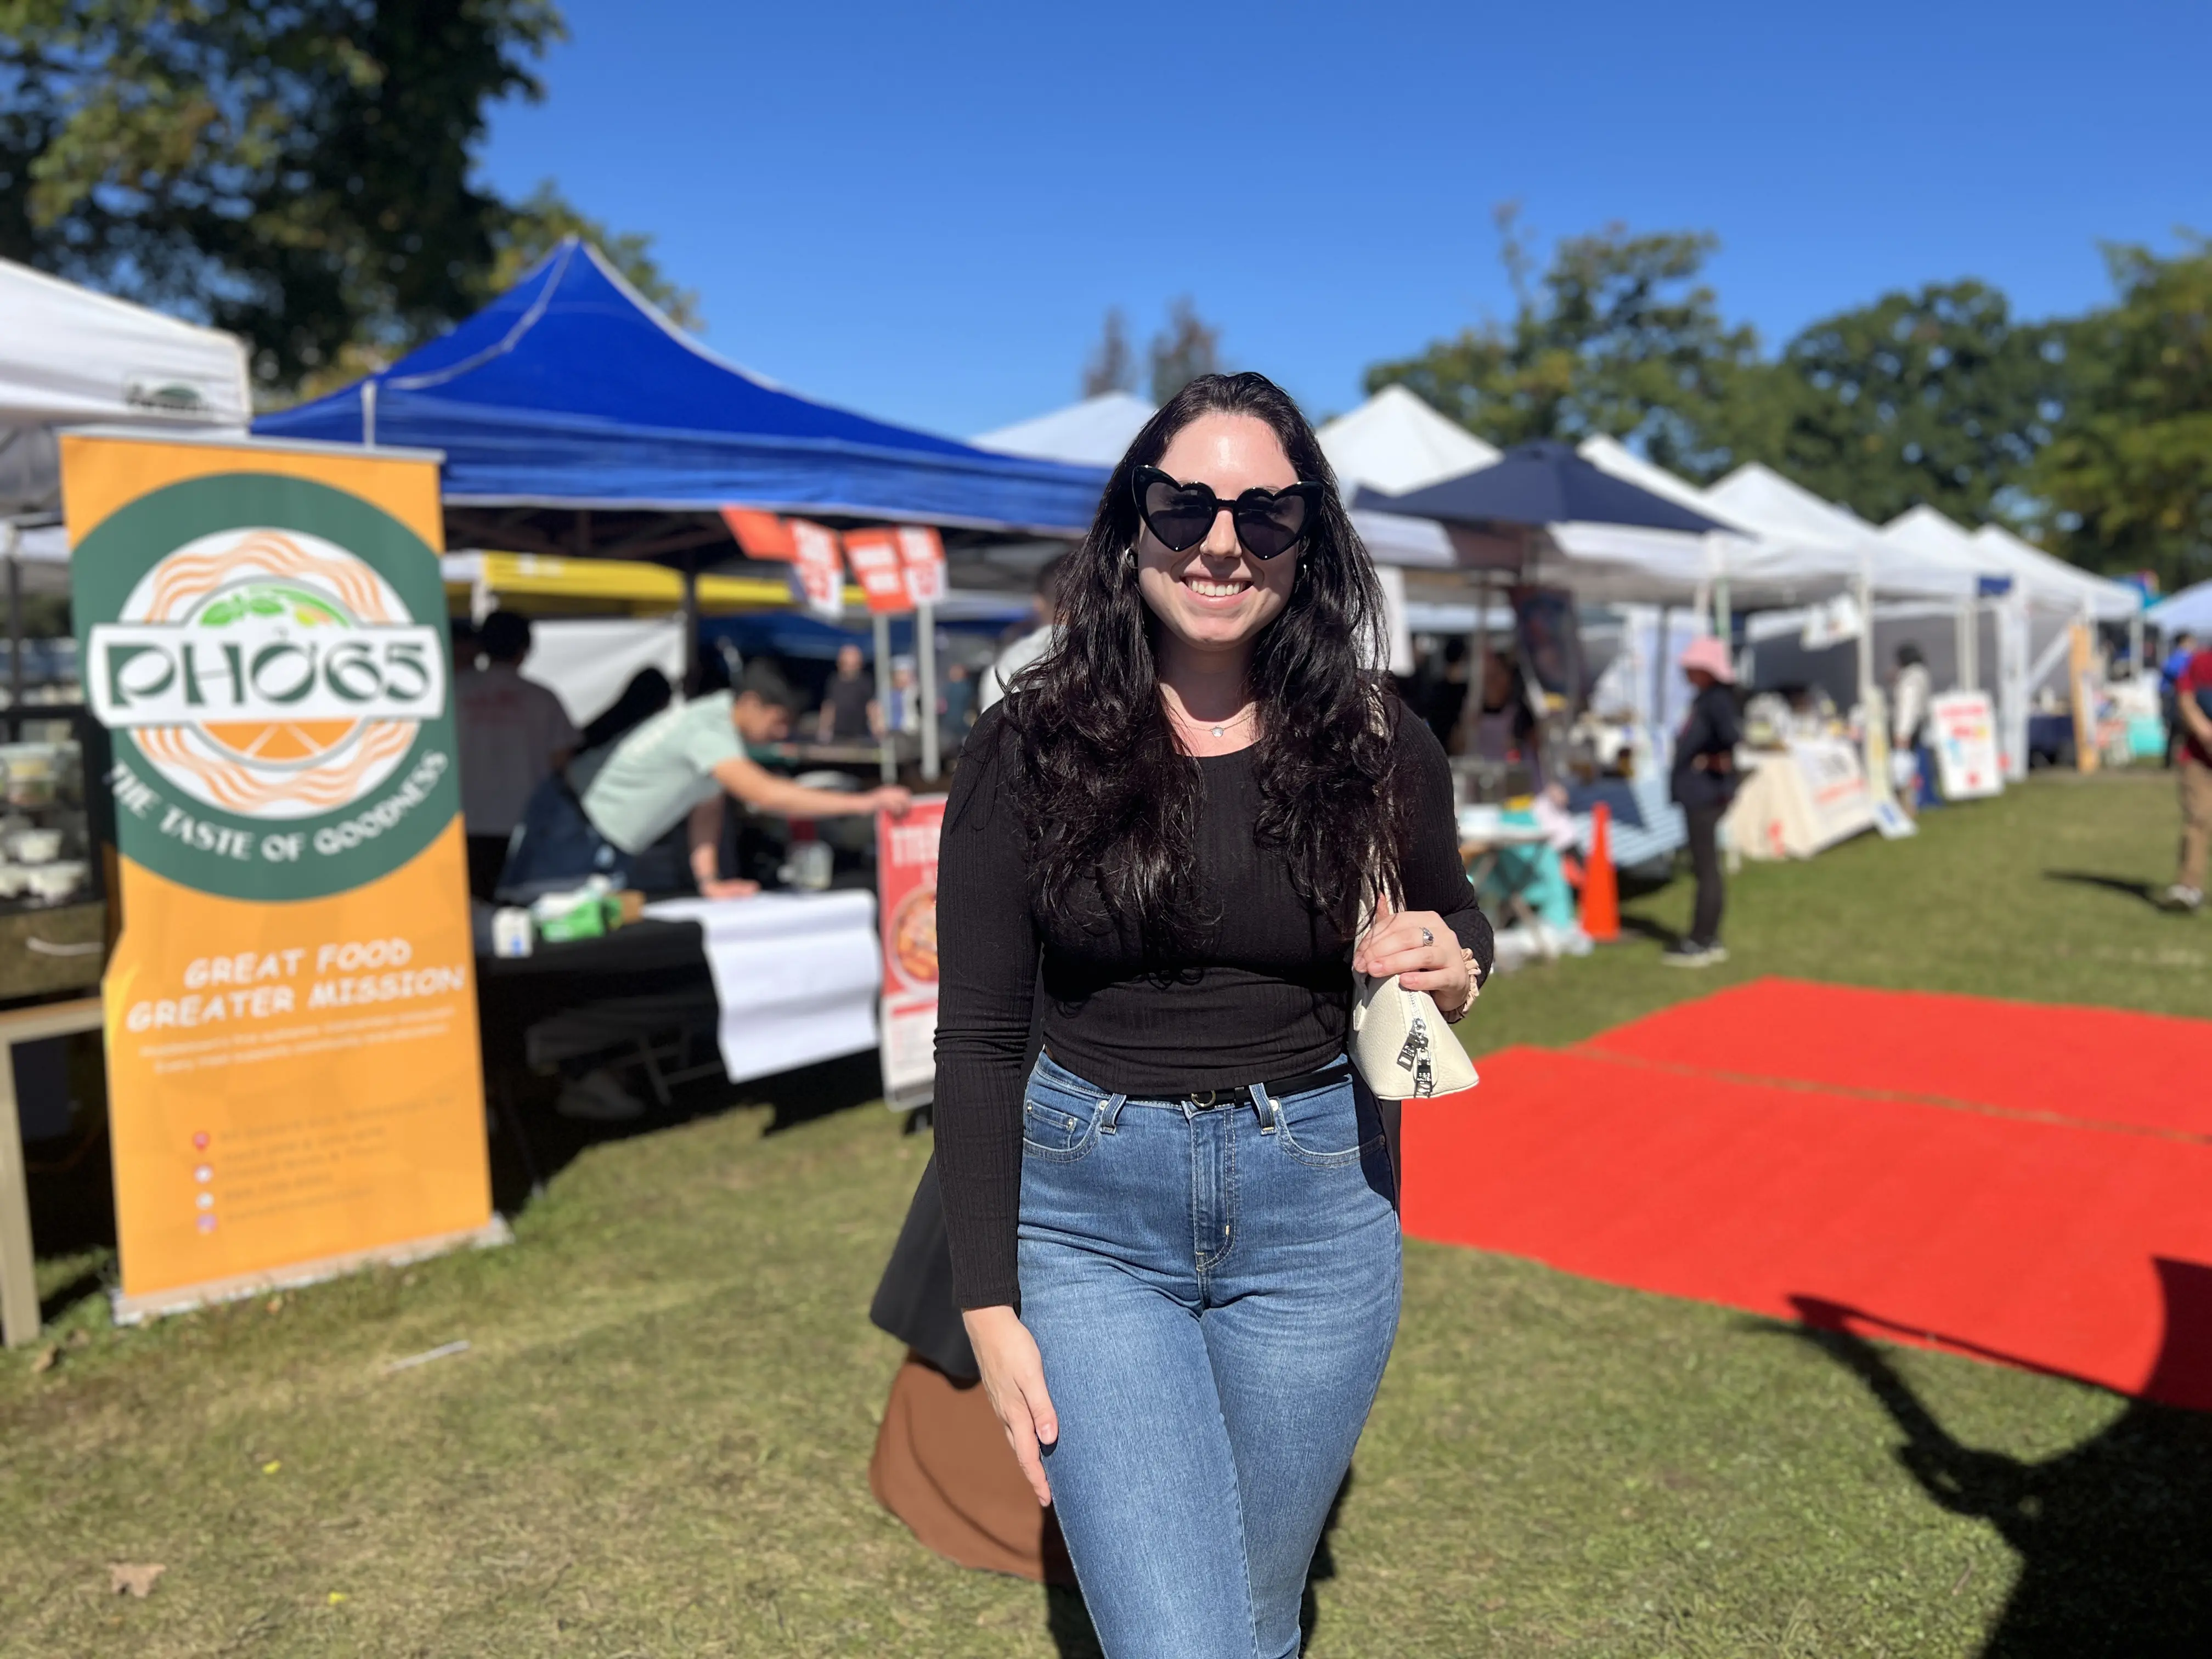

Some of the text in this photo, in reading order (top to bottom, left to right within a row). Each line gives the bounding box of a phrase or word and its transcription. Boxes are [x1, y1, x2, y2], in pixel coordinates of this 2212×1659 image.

[106, 749, 448, 861] THE TASTE OF GOODNESS
[184, 938, 413, 989] GREAT FOOD
[127, 964, 465, 1031] GREATER MISSION
